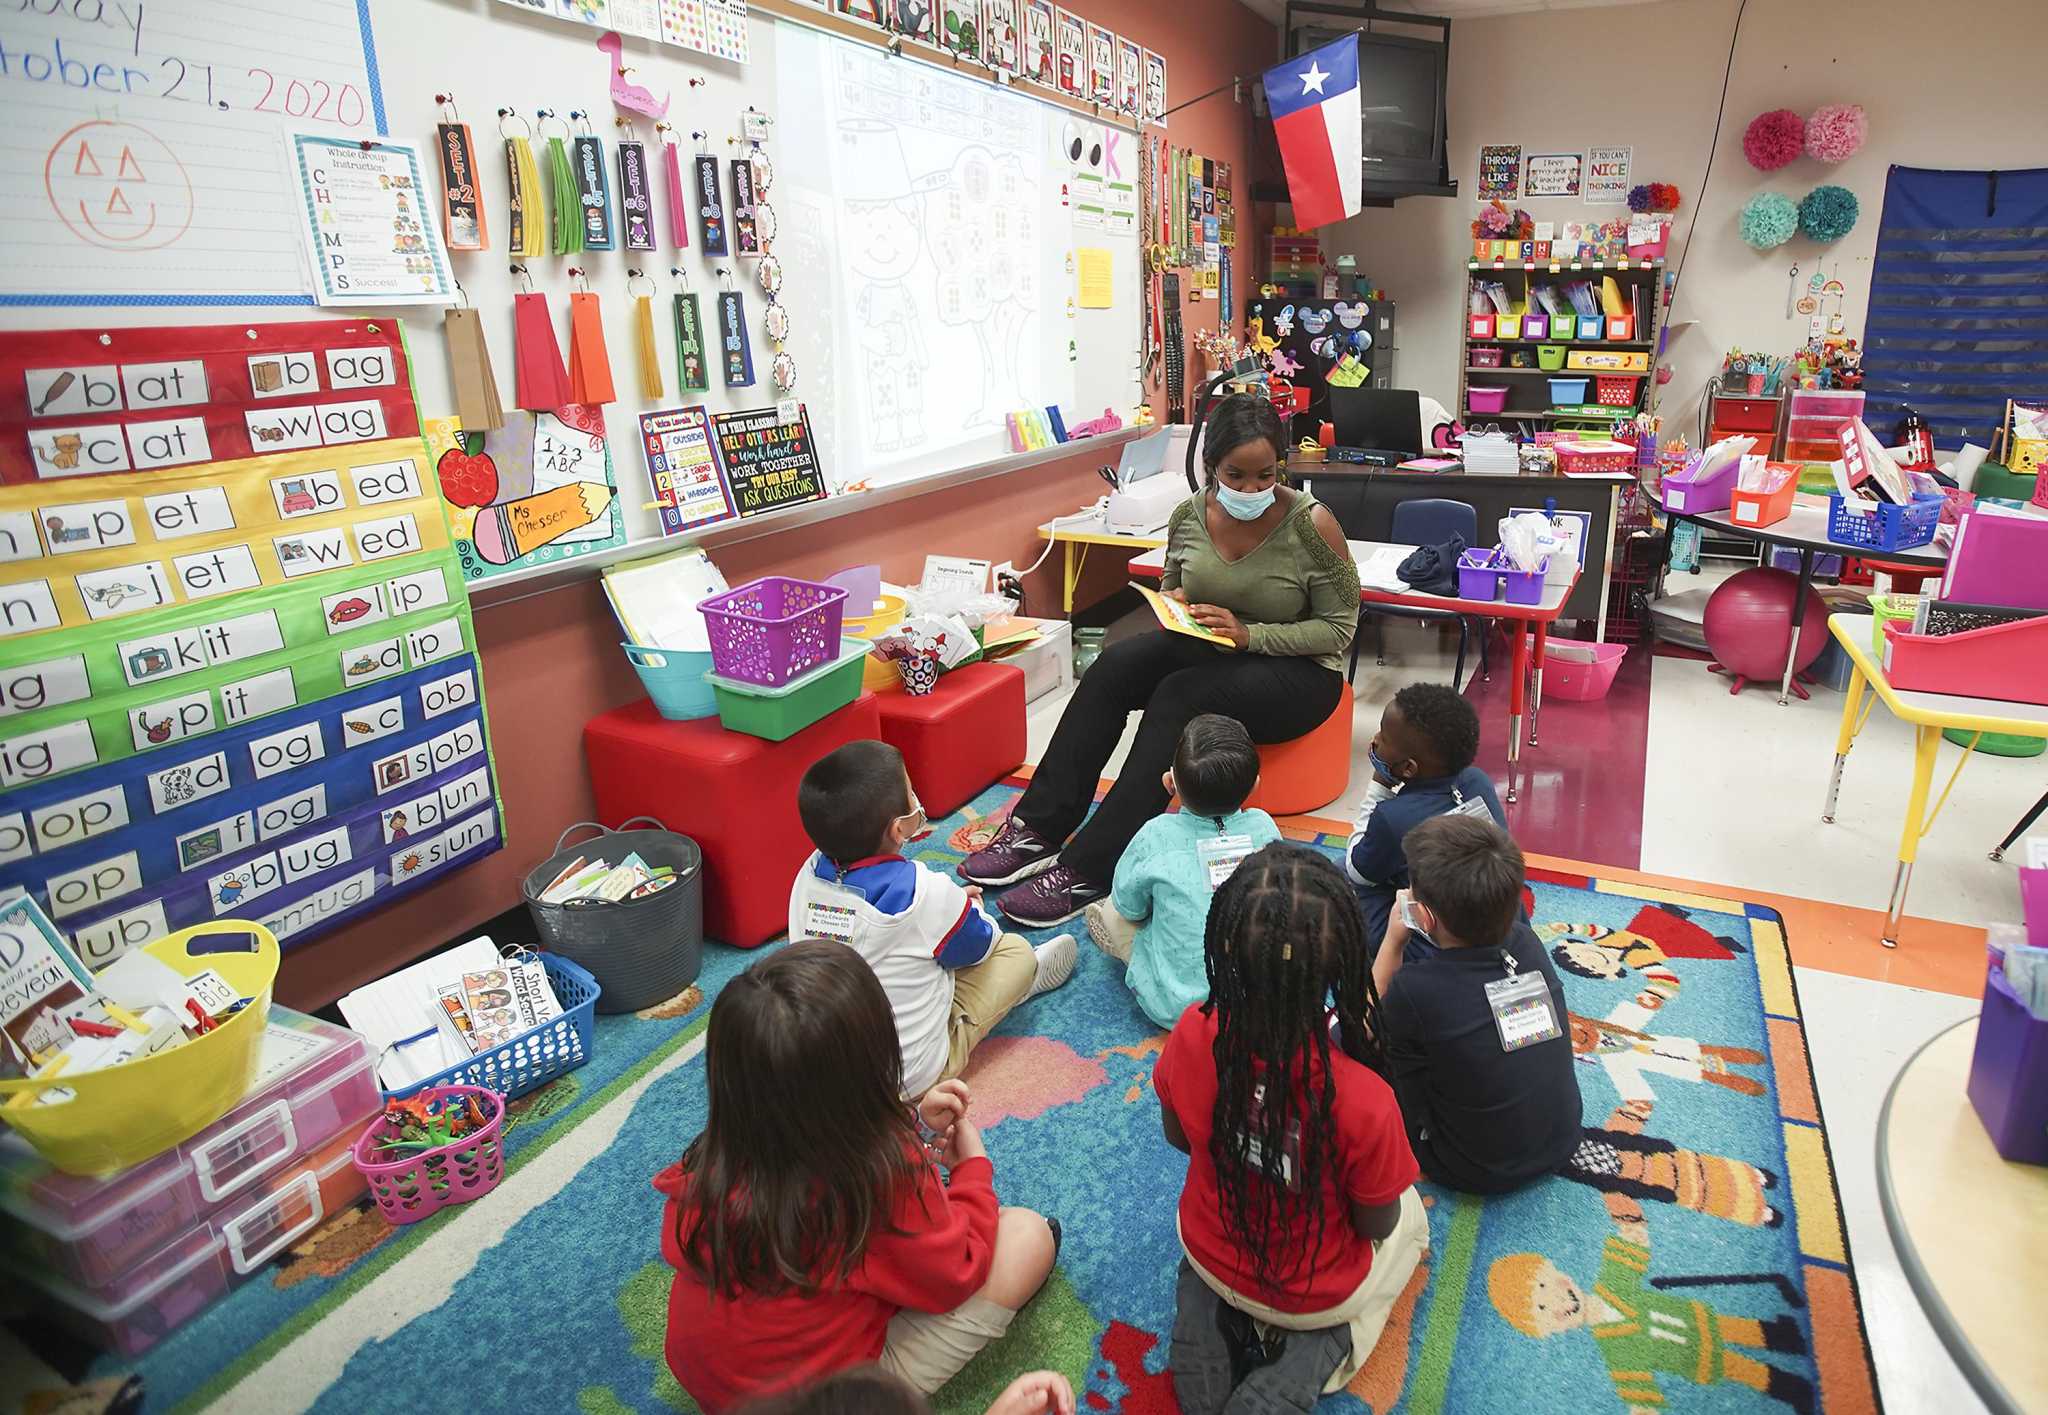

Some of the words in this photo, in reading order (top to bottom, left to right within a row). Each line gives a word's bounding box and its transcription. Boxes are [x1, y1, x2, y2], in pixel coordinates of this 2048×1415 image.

[248, 69, 365, 127] 2020
[1488, 173, 1510, 182] LIKE
[1591, 163, 1626, 176] NICE
[722, 434, 745, 450] HELP
[746, 428, 779, 447] OTHERS
[779, 424, 805, 441] LEARN
[730, 464, 758, 479] WORK
[761, 453, 812, 473] TOGETHER
[744, 489, 761, 507] ASK
[763, 477, 814, 502] QUESTIONS
[514, 506, 530, 520] Ms
[512, 967, 527, 995] Word
[527, 973, 546, 1005] Short
